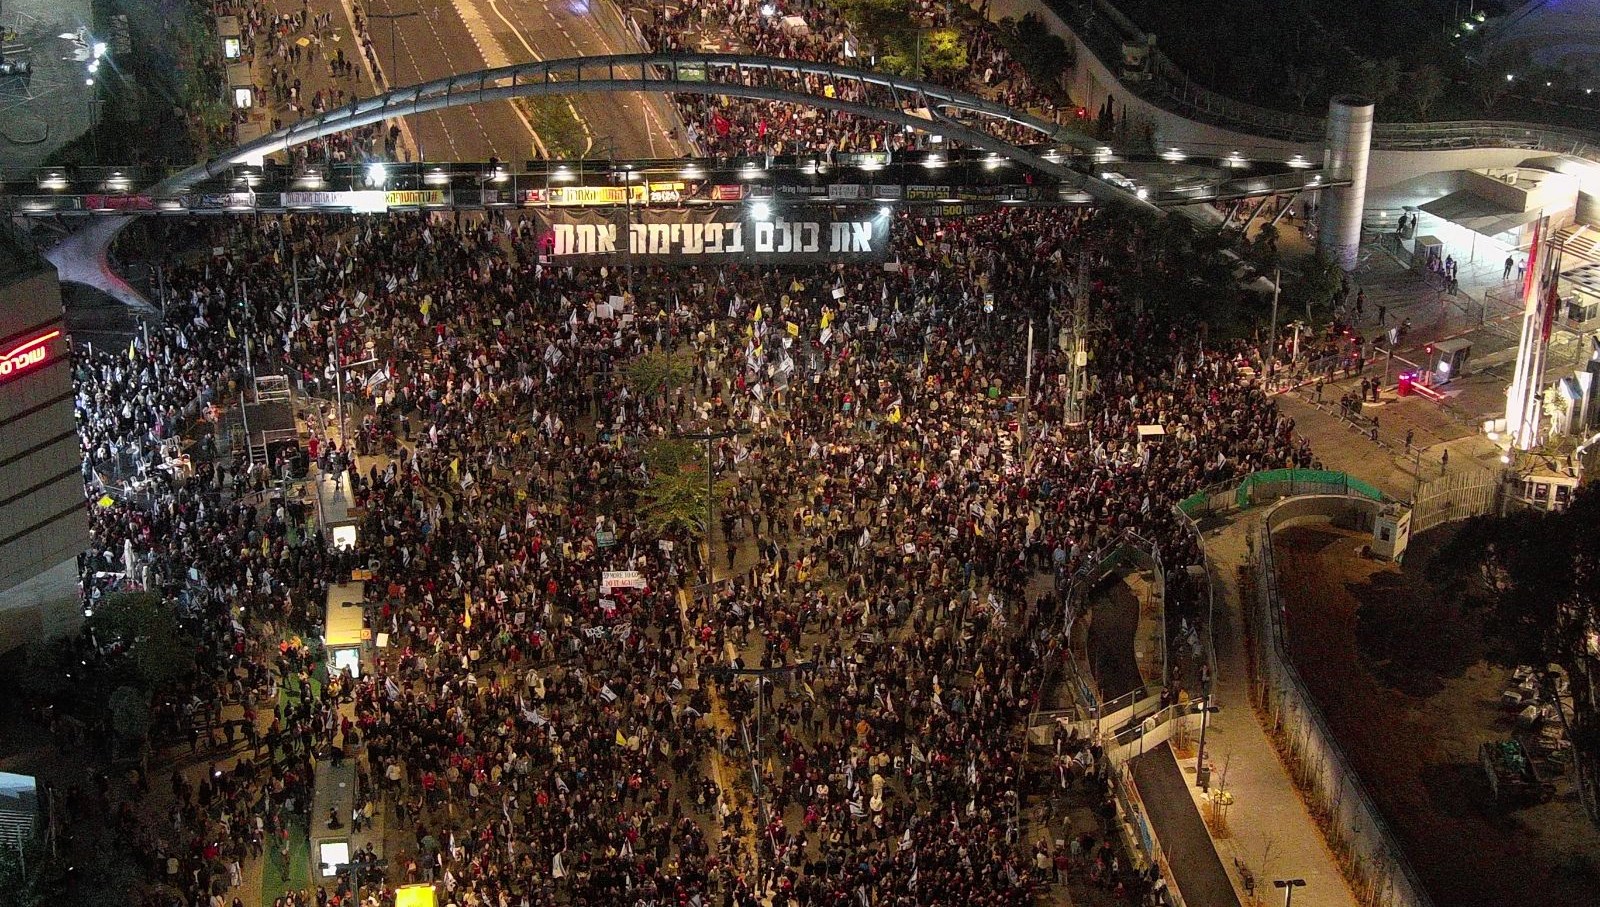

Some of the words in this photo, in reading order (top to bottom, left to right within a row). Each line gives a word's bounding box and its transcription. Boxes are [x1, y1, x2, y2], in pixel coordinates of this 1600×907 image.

[782, 185, 795, 194] Bring
[943, 205, 962, 215] 500
[553, 224, 617, 255] אחת
[630, 222, 745, 254] בפעימה
[755, 217, 820, 252] כולם
[830, 222, 872, 252] את
[0, 346, 46, 375] שופרס
